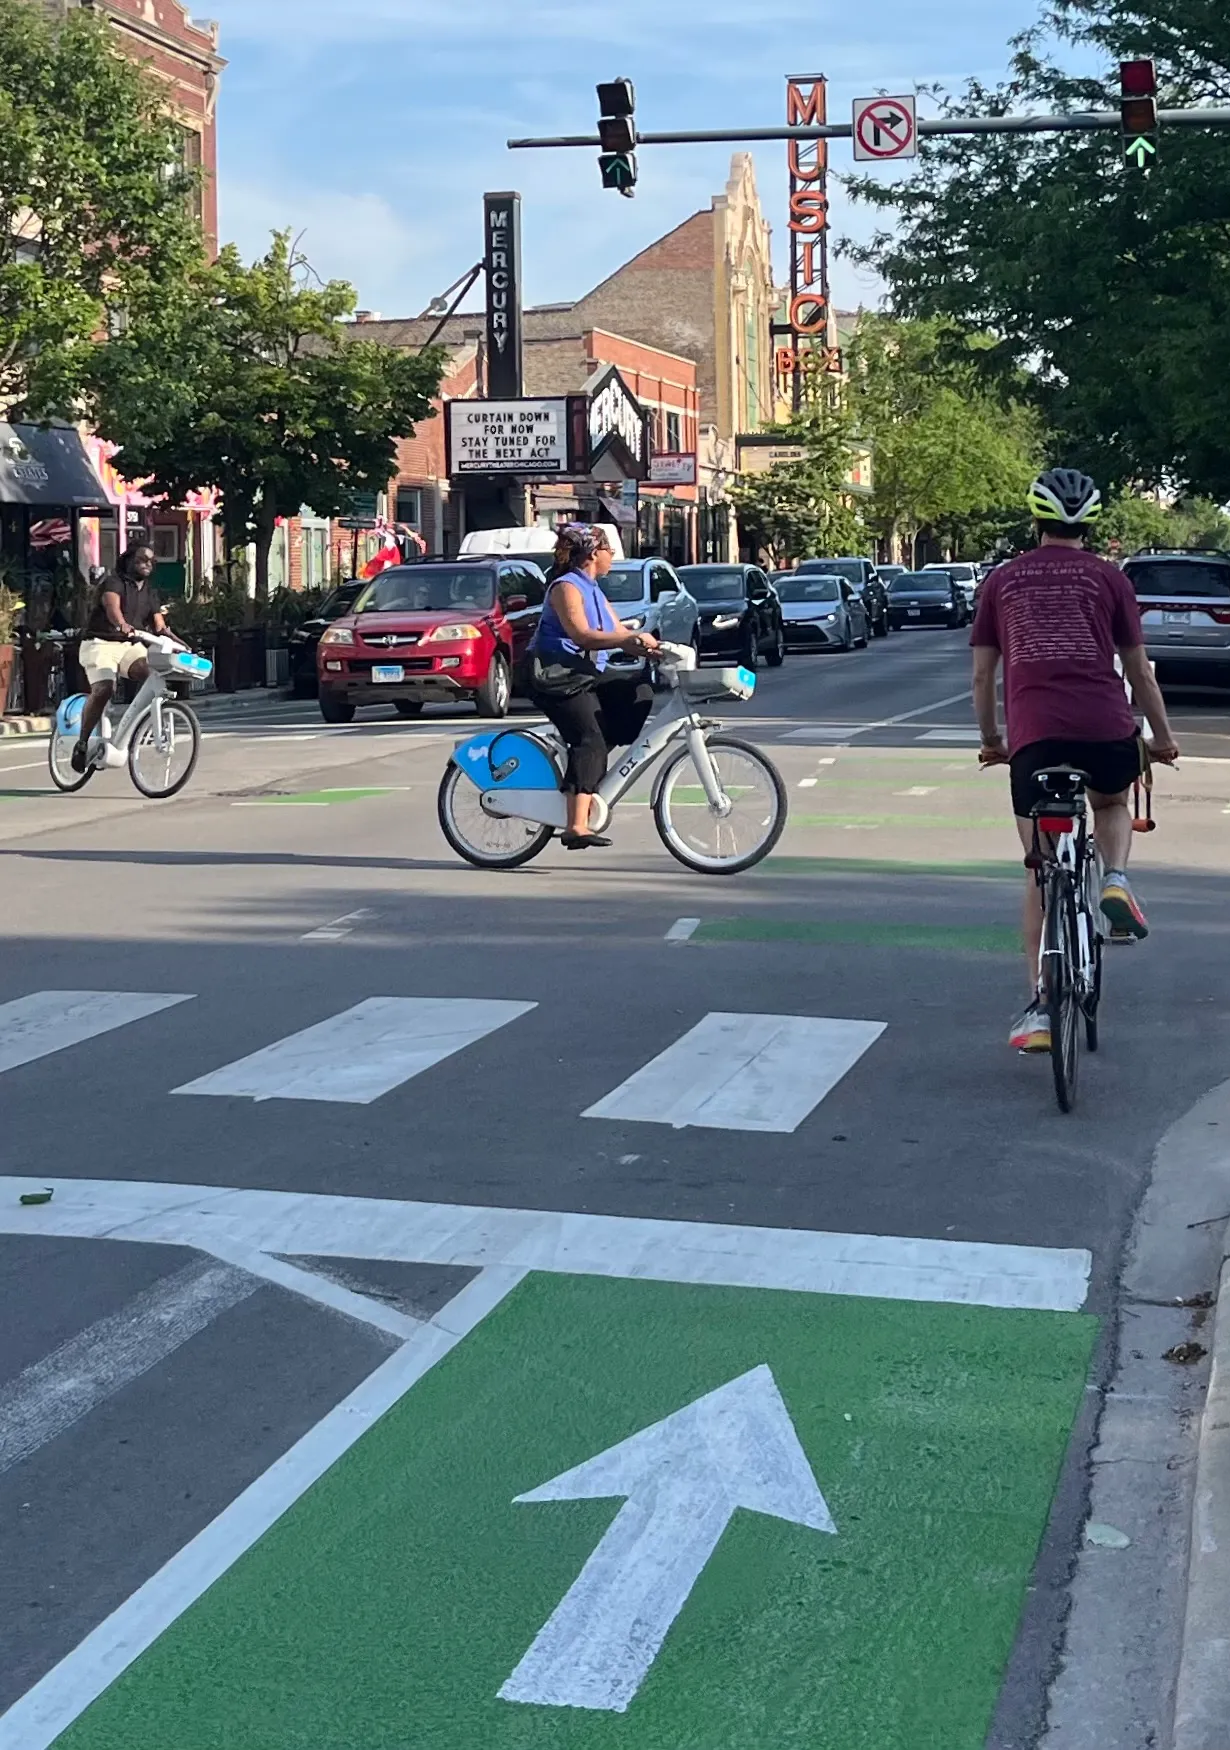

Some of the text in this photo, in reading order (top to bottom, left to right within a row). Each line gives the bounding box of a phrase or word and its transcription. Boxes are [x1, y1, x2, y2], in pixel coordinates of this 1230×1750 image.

[787, 82, 828, 334] MUSIC
[490, 210, 509, 353] MERCURY
[467, 411, 550, 423] CURTAIN DOWN
[484, 424, 534, 435] FOR NOW
[461, 436, 556, 447] STAY TUNED FOR
[468, 448, 550, 458] THE NEXT ACT
